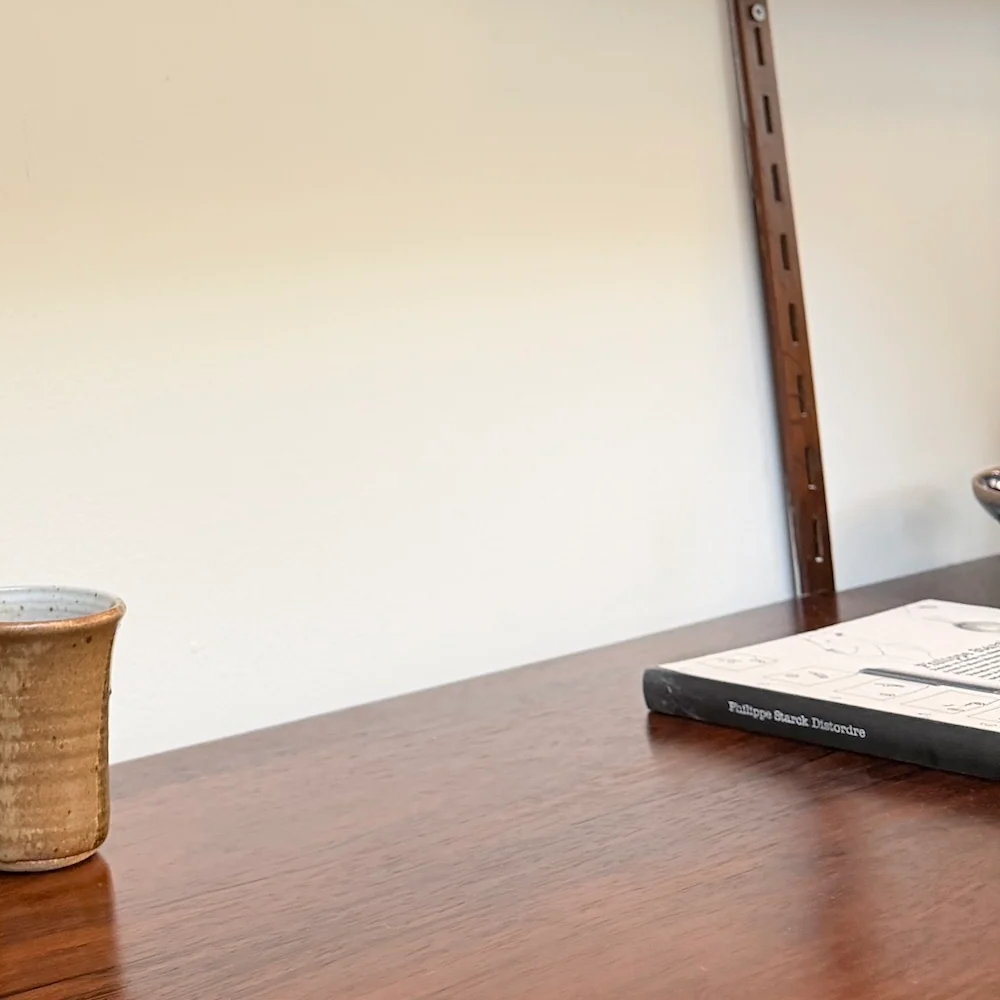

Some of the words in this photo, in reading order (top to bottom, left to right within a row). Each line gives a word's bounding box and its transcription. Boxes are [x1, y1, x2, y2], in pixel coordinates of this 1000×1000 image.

[727, 700, 772, 721] Philippe
[773, 709, 809, 727] Starck
[811, 717, 867, 739] Distordre
